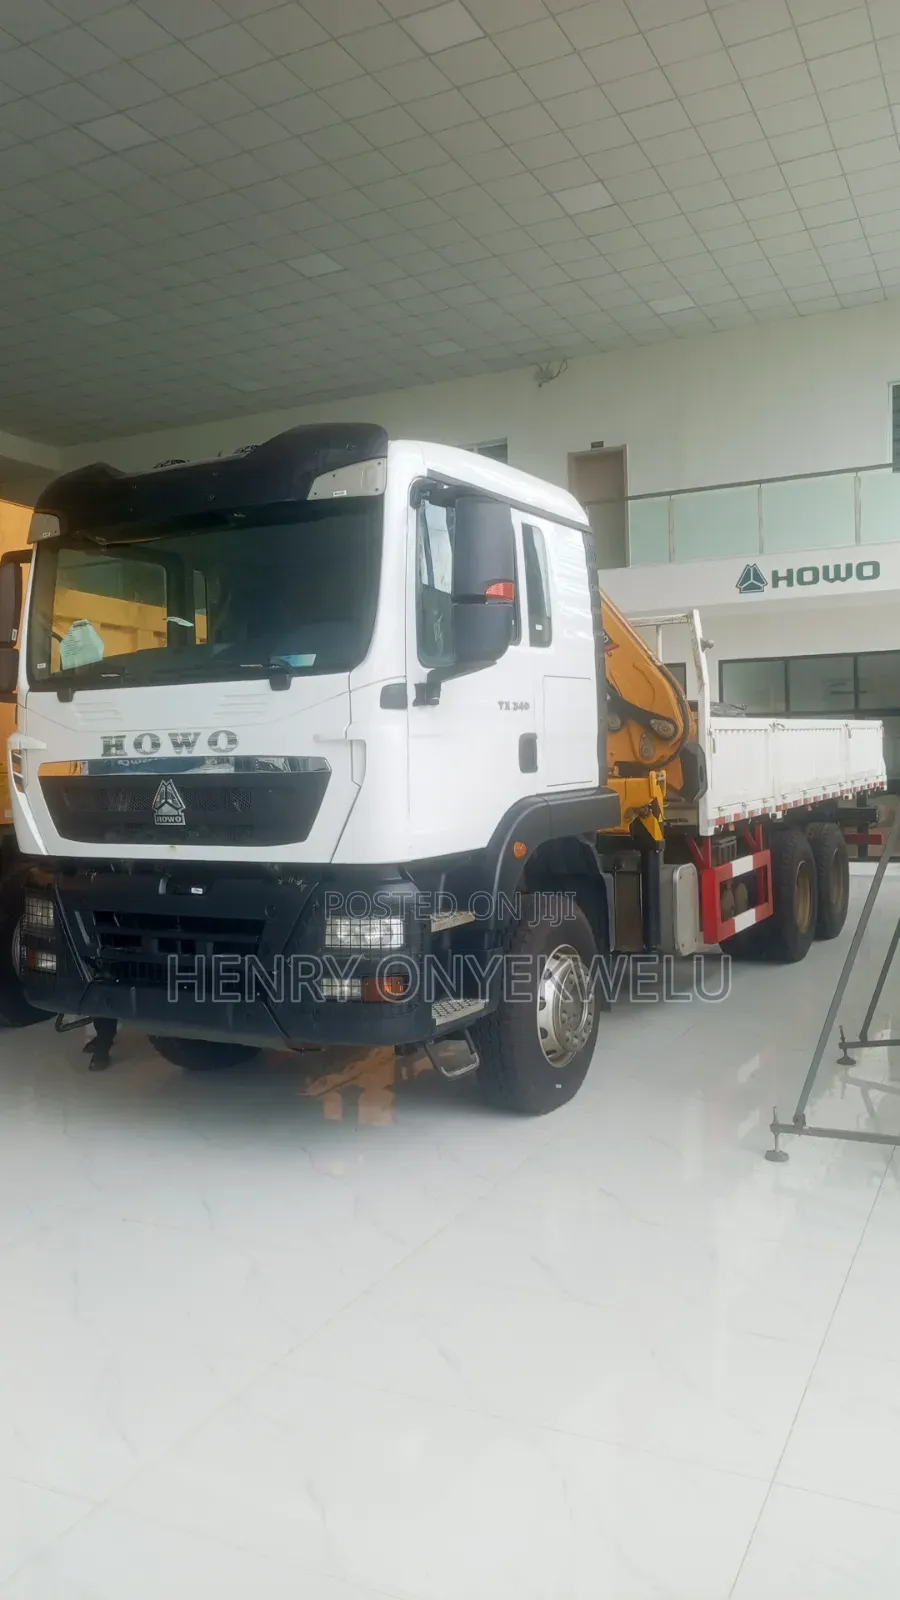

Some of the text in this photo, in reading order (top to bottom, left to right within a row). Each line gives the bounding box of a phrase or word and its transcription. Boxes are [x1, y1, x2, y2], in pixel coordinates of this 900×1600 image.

[771, 561, 880, 588] HOWO
[100, 730, 239, 757] HOWO
[156, 815, 182, 823] HOWO
